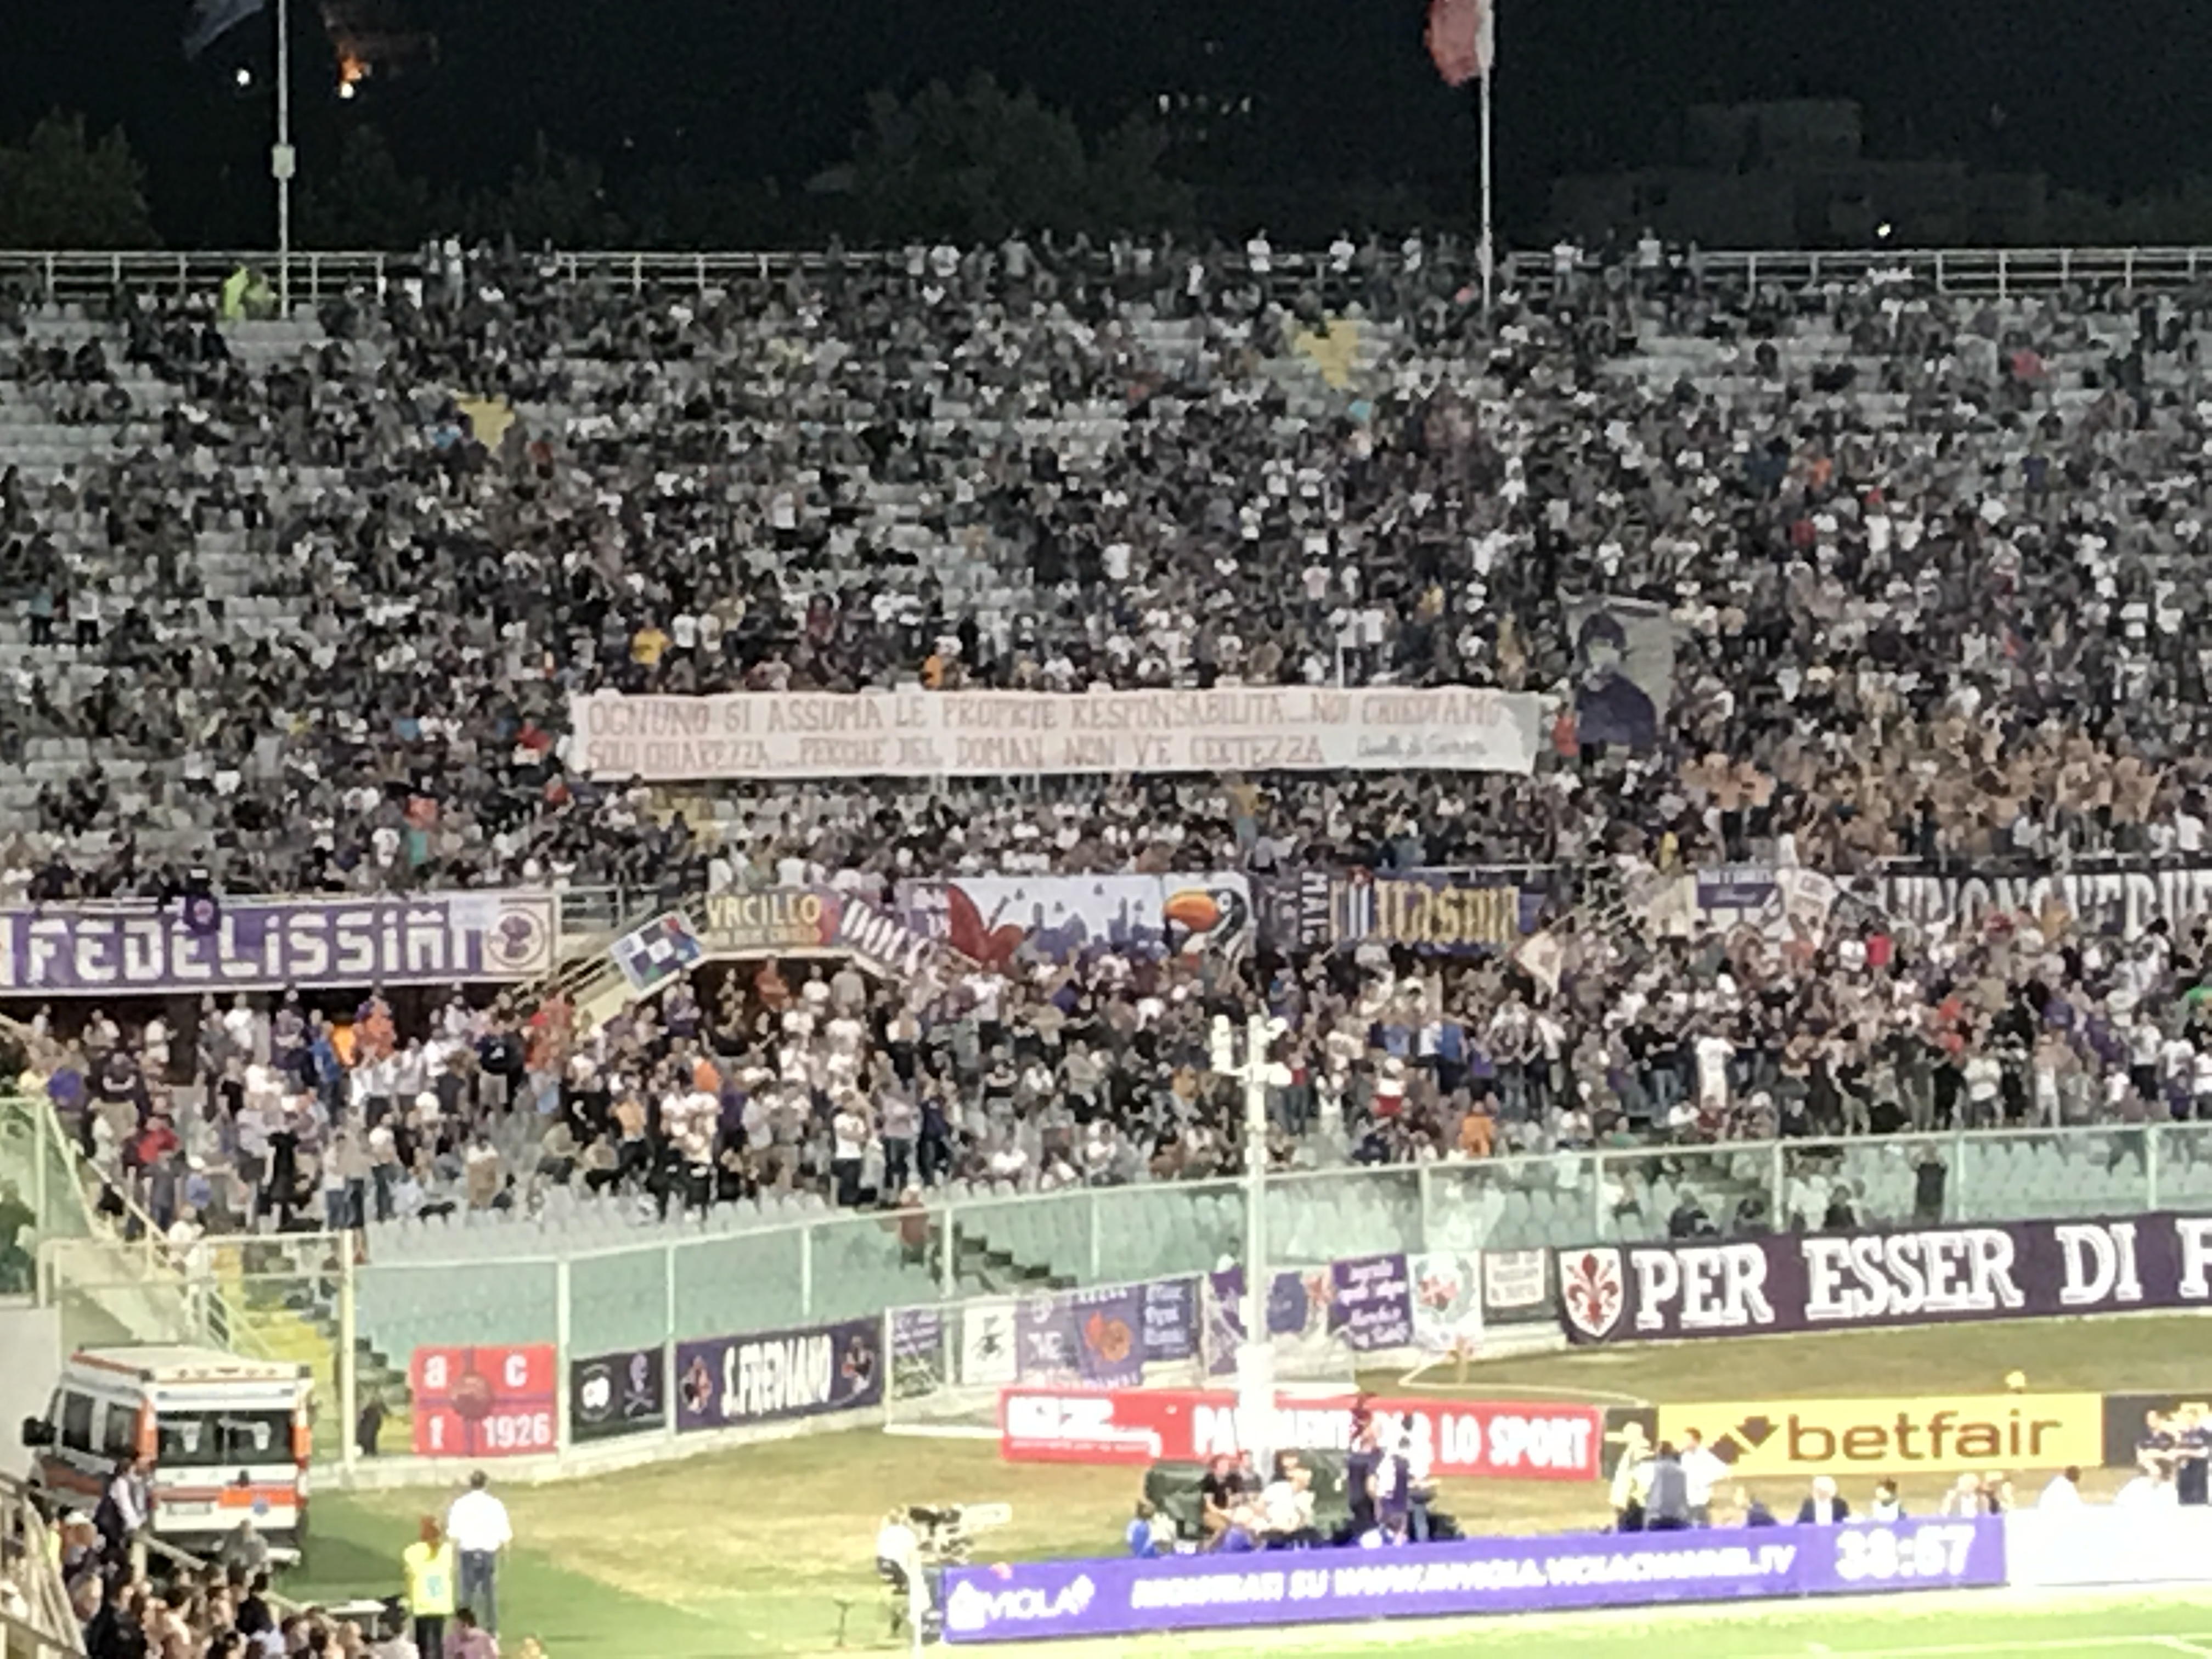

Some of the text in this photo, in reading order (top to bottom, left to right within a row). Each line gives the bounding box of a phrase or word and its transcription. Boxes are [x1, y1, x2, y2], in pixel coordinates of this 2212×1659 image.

[588, 699, 710, 736] OGNUNO
[724, 699, 753, 733] SI
[767, 697, 884, 733] ASSUMA
[895, 695, 928, 728] LE
[942, 697, 1058, 731] PROPRIE
[1630, 1243, 1775, 1331] PER
[1802, 1228, 2025, 1321] ESSER
[2054, 1223, 2143, 1305] DI
[481, 1412, 551, 1449] 1926
[1440, 1412, 1481, 1464] LO
[1488, 1415, 1592, 1469] SPORT
[1788, 1408, 2062, 1462] betfair
